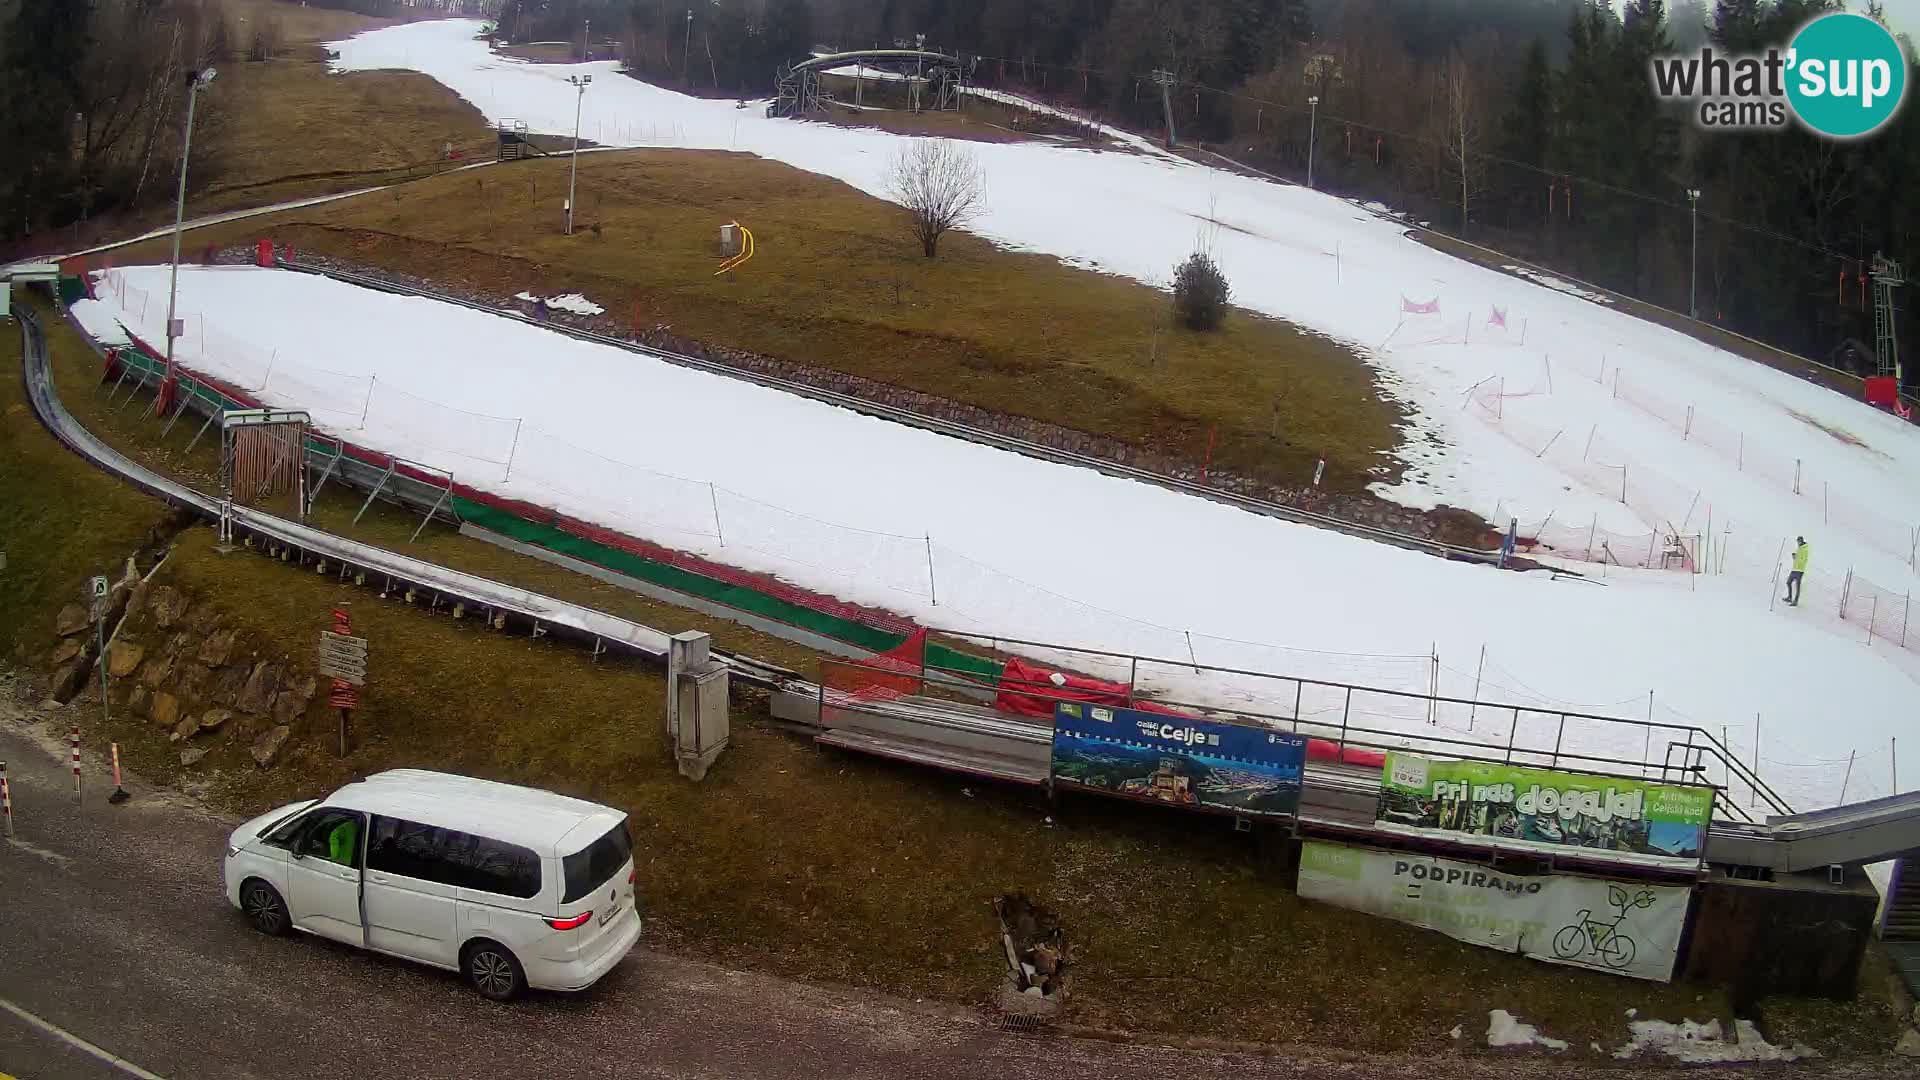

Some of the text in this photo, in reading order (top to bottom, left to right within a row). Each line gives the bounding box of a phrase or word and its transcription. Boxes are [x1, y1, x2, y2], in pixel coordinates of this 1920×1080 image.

[1160, 723, 1206, 746] Celje
[1432, 779, 1469, 801] Pri
[1472, 782, 1515, 803] nas
[1394, 860, 1542, 895] PODPIRAMO
